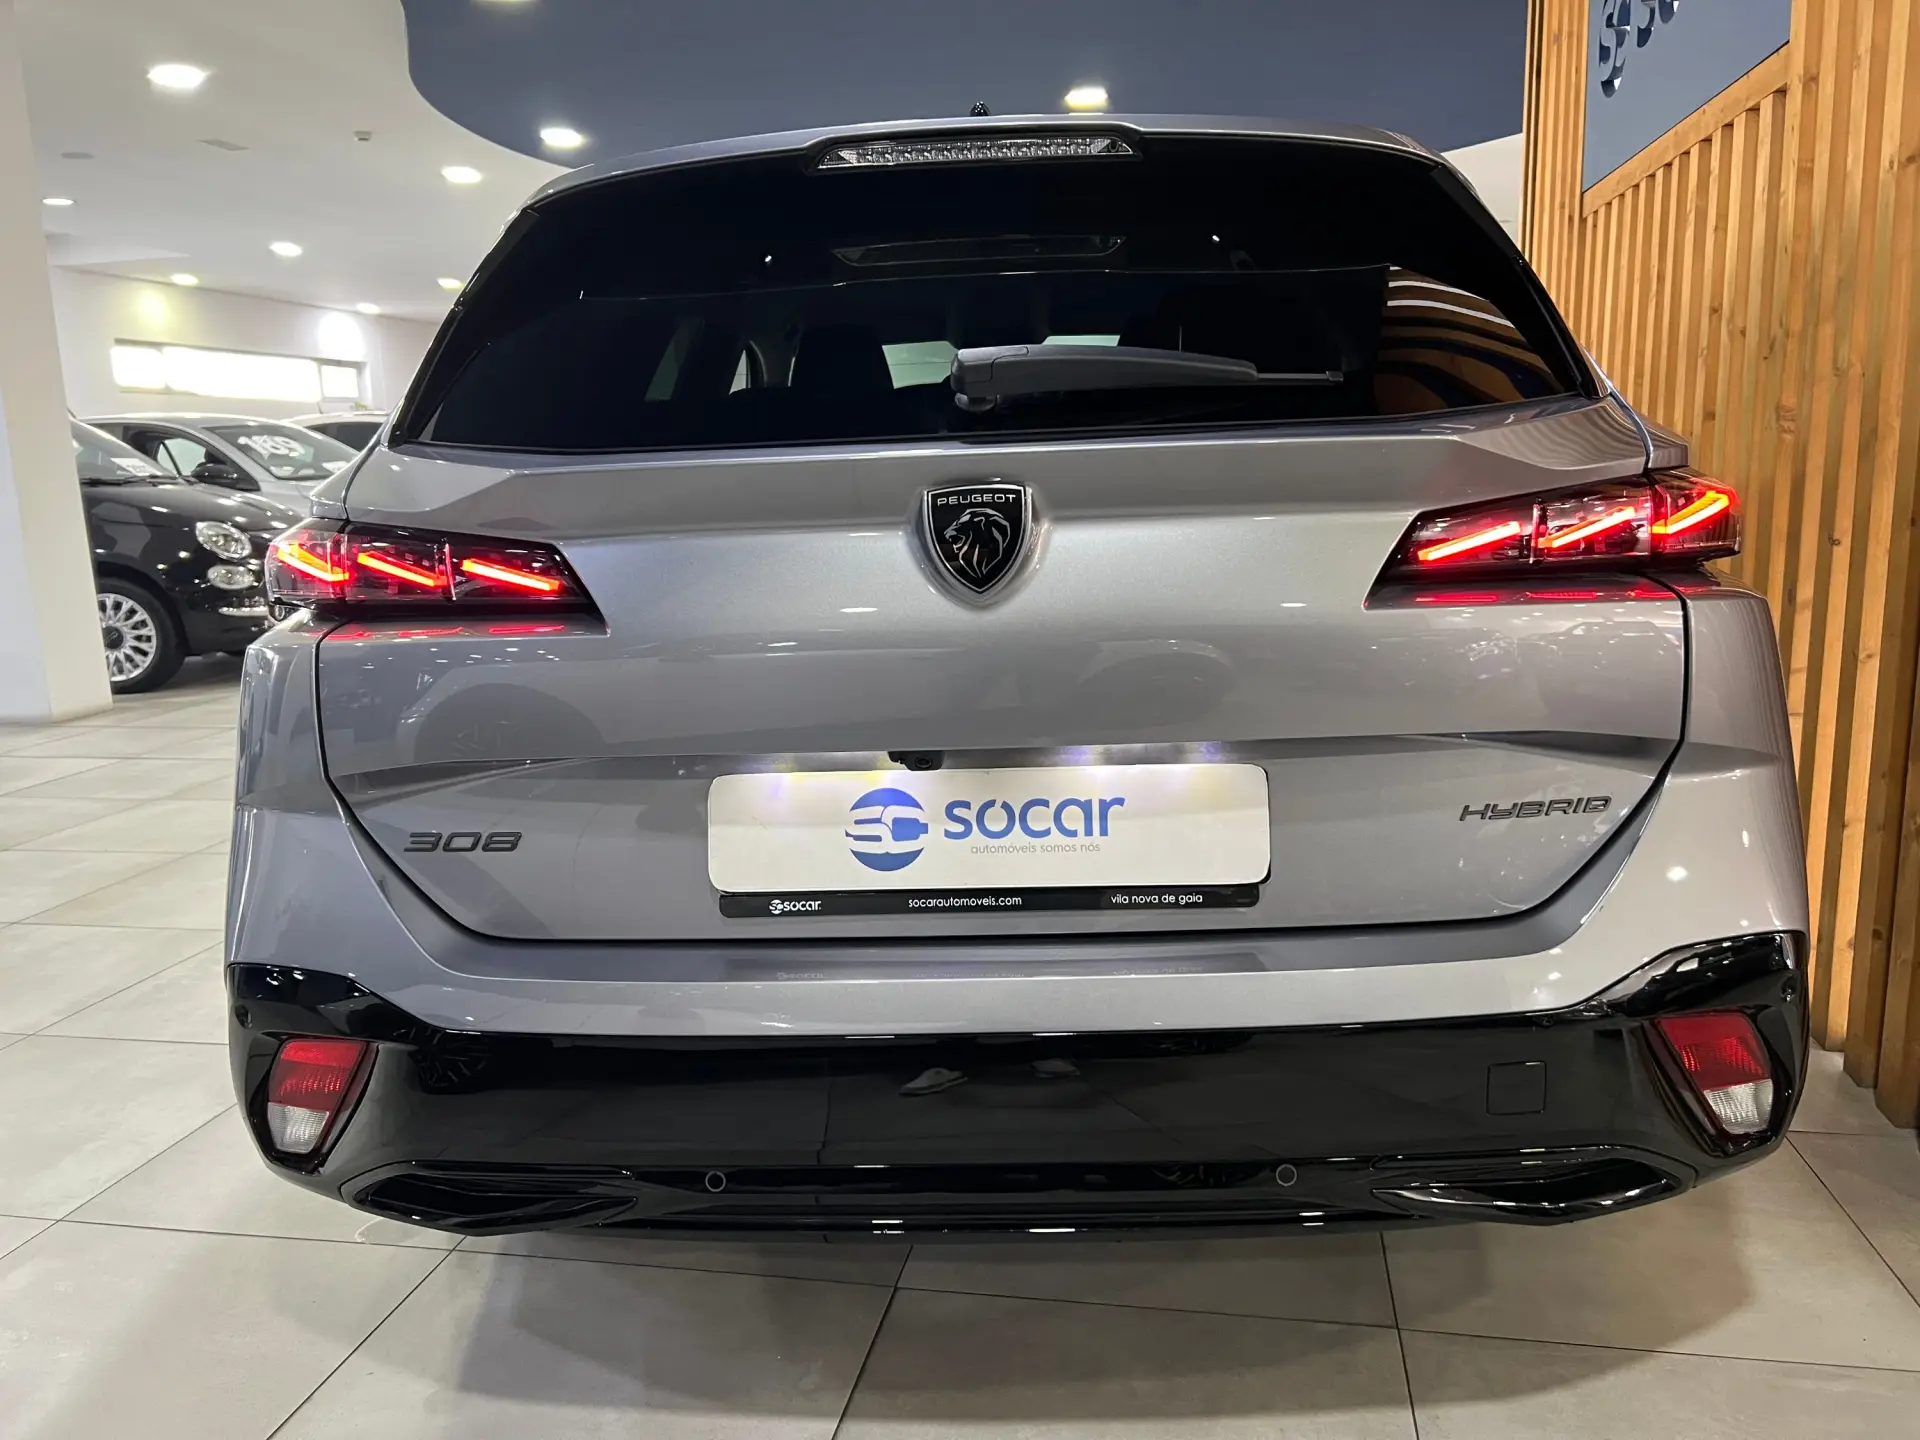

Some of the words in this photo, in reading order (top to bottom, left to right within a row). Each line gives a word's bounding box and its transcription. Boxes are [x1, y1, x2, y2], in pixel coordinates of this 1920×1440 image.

[937, 494, 1016, 506] PEUGEOT
[1459, 795, 1612, 822] HYBRID
[944, 797, 1126, 840] socar
[403, 831, 523, 852] 308
[970, 842, 1037, 854] automóveis
[1040, 843, 1077, 853] somos
[1080, 841, 1100, 852] nós
[908, 895, 1022, 908] socarautomoveis.com
[1110, 894, 1129, 904] vila
[1131, 895, 1159, 904] nova
[1161, 893, 1176, 903] de
[1178, 892, 1203, 905] gaia
[783, 900, 821, 911] socar
